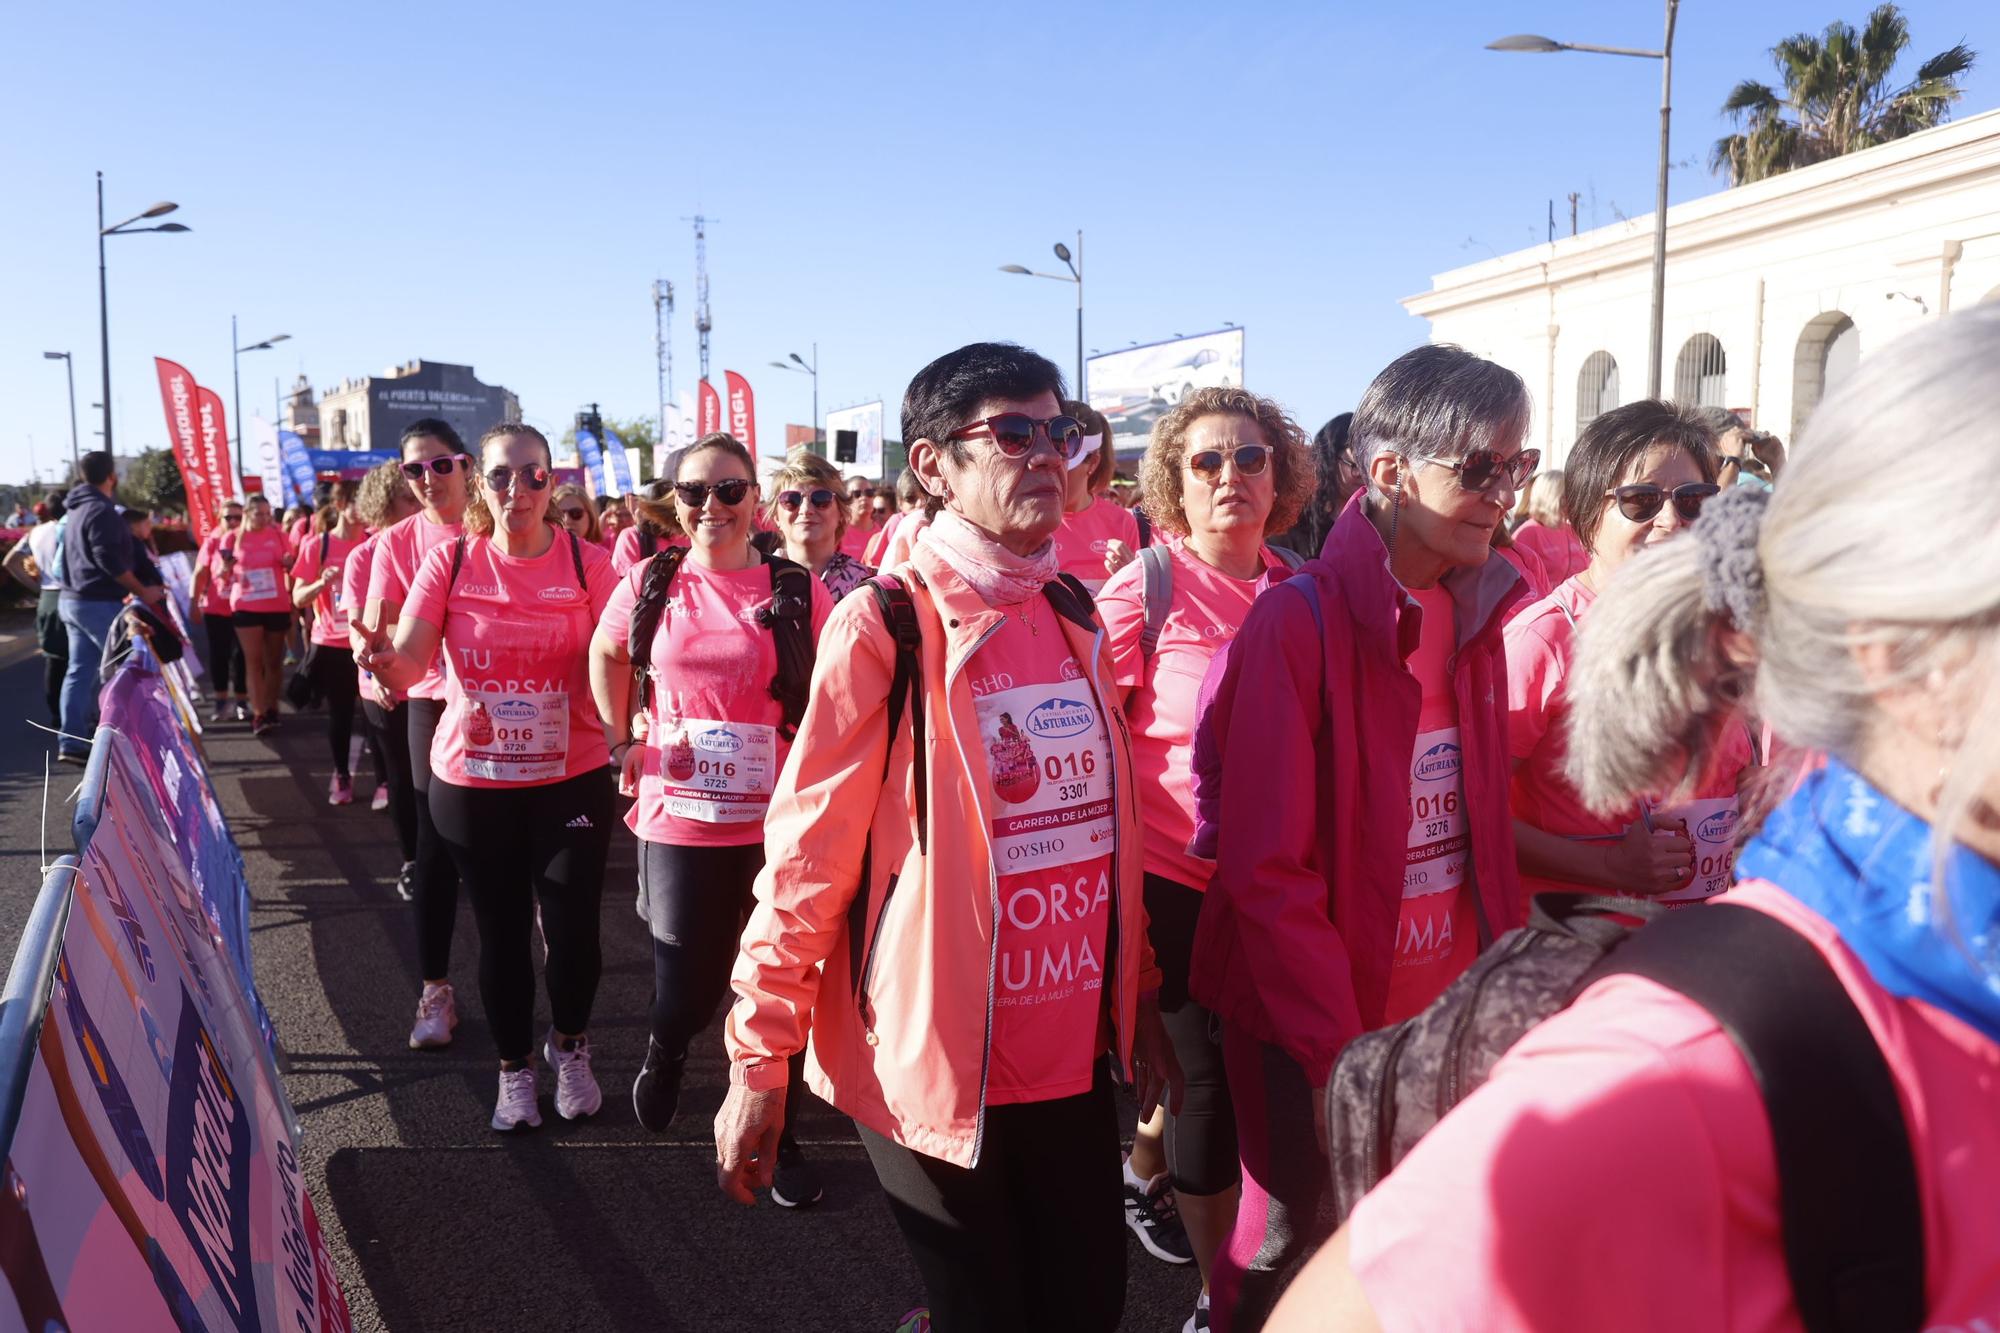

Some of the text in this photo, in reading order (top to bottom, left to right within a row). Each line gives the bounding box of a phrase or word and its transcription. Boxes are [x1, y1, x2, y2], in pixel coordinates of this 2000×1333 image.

[460, 648, 491, 670] TU
[971, 673, 1013, 697] SHO
[496, 707, 536, 718] ASTURIANA
[1033, 713, 1091, 732] ASTURIANA
[497, 728, 533, 741] 016
[700, 737, 740, 749] ASTURIANA
[504, 743, 527, 752] 5726
[698, 760, 736, 777] 016
[1044, 749, 1095, 780] 016
[1417, 757, 1460, 776] ASTURIAN
[704, 778, 728, 789] 5725
[1059, 781, 1089, 801] 3301
[673, 788, 702, 798] CARRERA
[728, 808, 762, 816] Santander
[1416, 791, 1457, 819] 016
[1009, 814, 1060, 831] CARRERA
[1062, 811, 1076, 822] DE
[1078, 808, 1088, 819] LA
[1088, 803, 1108, 817] MUJER
[1425, 820, 1449, 838] 3276
[1007, 838, 1065, 860] OYSHO
[1407, 850, 1426, 860] RERA
[1427, 847, 1436, 857] DE
[1436, 844, 1445, 853] LA
[1403, 871, 1428, 887] SHO
[1705, 875, 1727, 892] 3275
[997, 869, 1109, 930] ORSA
[1002, 935, 1100, 991] UMA
[1020, 995, 1034, 1006] DE
[1036, 991, 1047, 1004] LA
